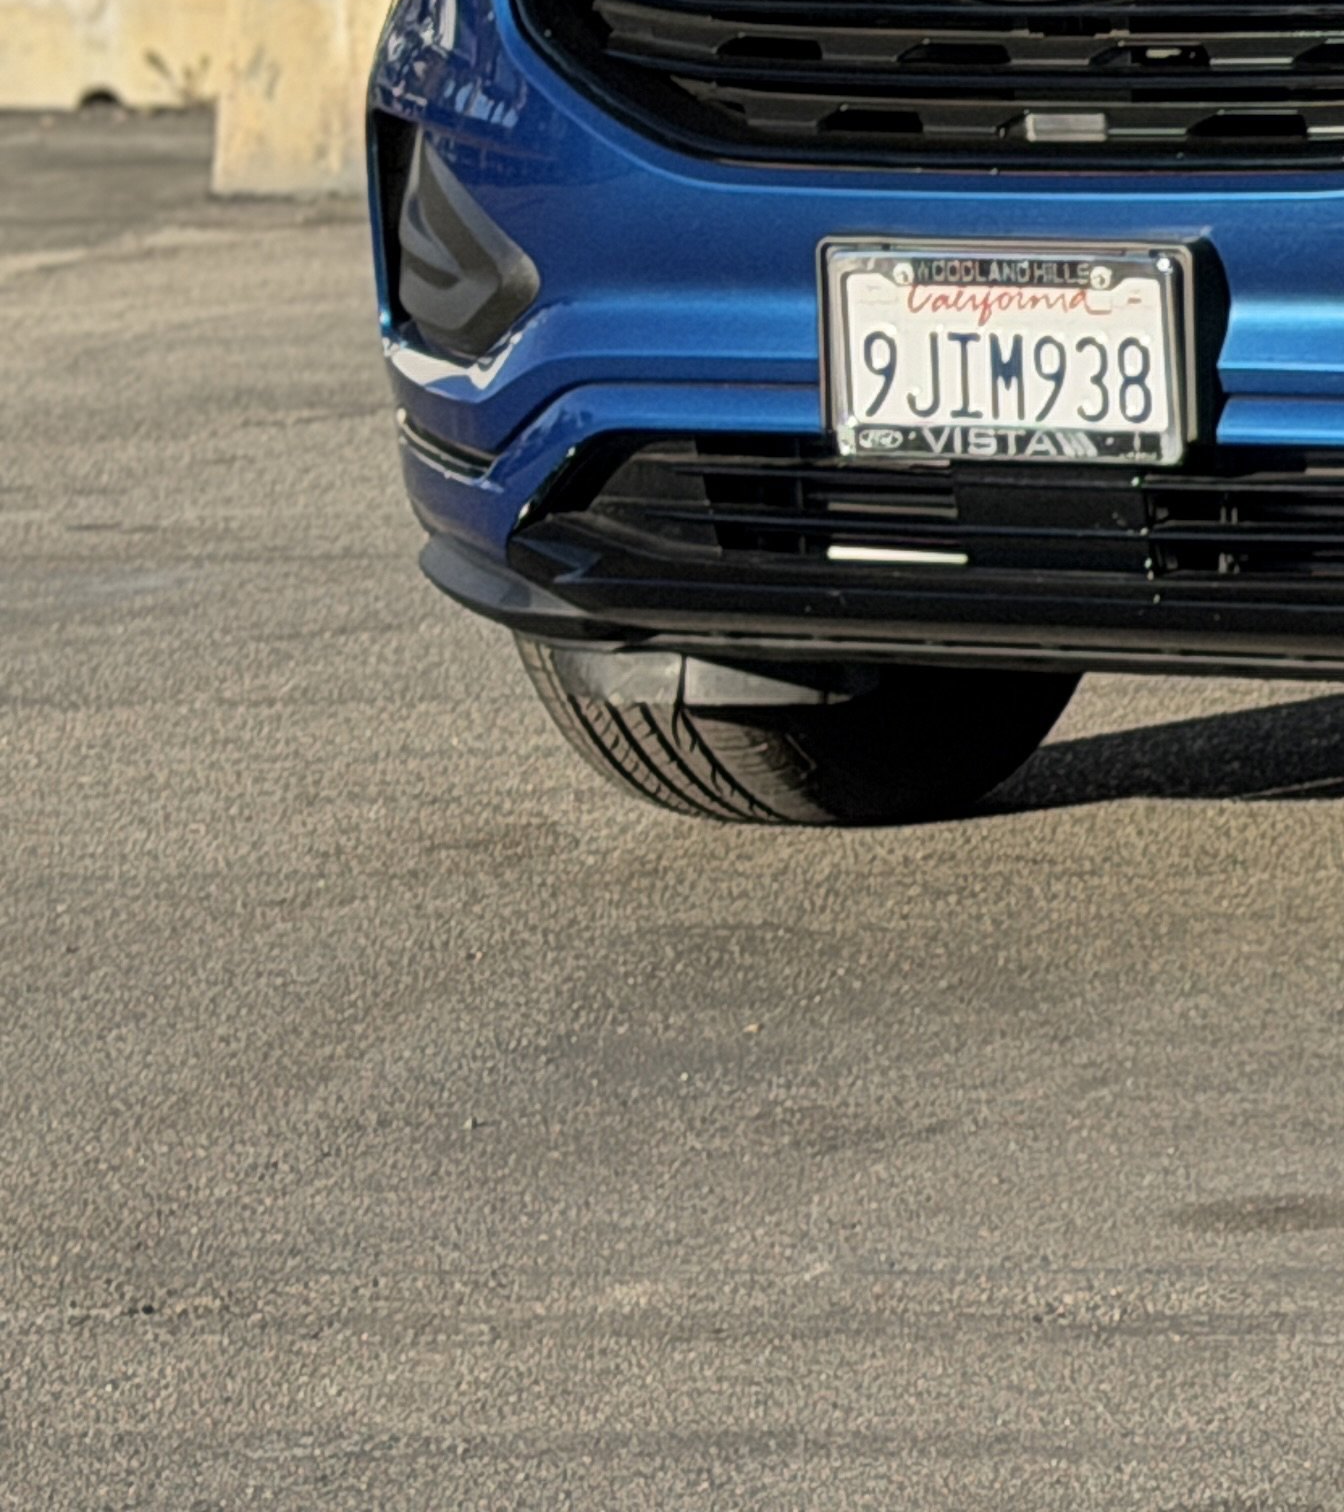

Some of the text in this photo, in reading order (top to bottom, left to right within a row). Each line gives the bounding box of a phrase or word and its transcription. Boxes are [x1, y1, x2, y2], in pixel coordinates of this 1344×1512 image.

[917, 259, 1090, 285] WOODLAND HILLS
[907, 284, 1112, 327] California
[863, 330, 1153, 423] 9JIM938
[921, 426, 1058, 457] VISTA
